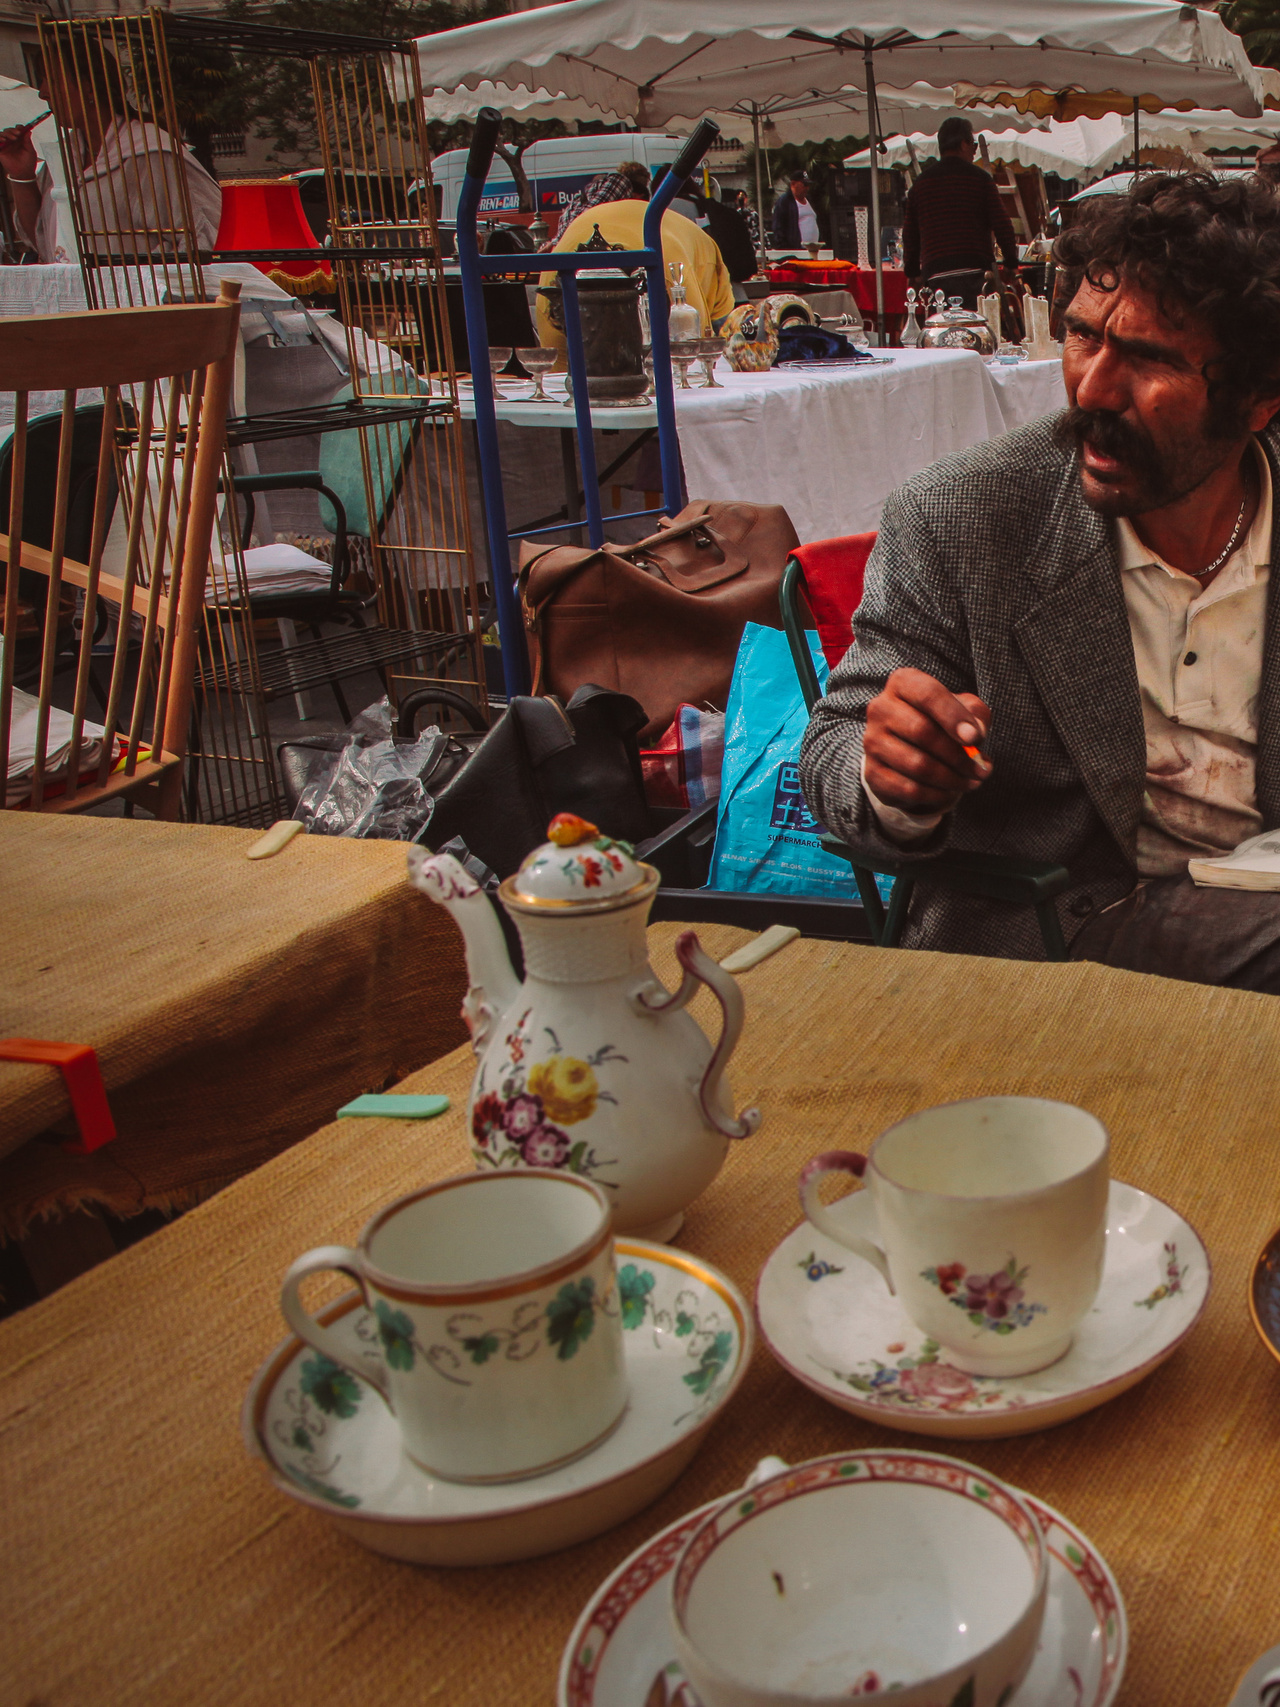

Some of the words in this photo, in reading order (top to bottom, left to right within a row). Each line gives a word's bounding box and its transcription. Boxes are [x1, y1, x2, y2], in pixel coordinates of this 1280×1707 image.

[480, 197, 500, 211] RENT
[503, 195, 520, 208] CAR
[767, 834, 822, 849] SUPERMARCH
